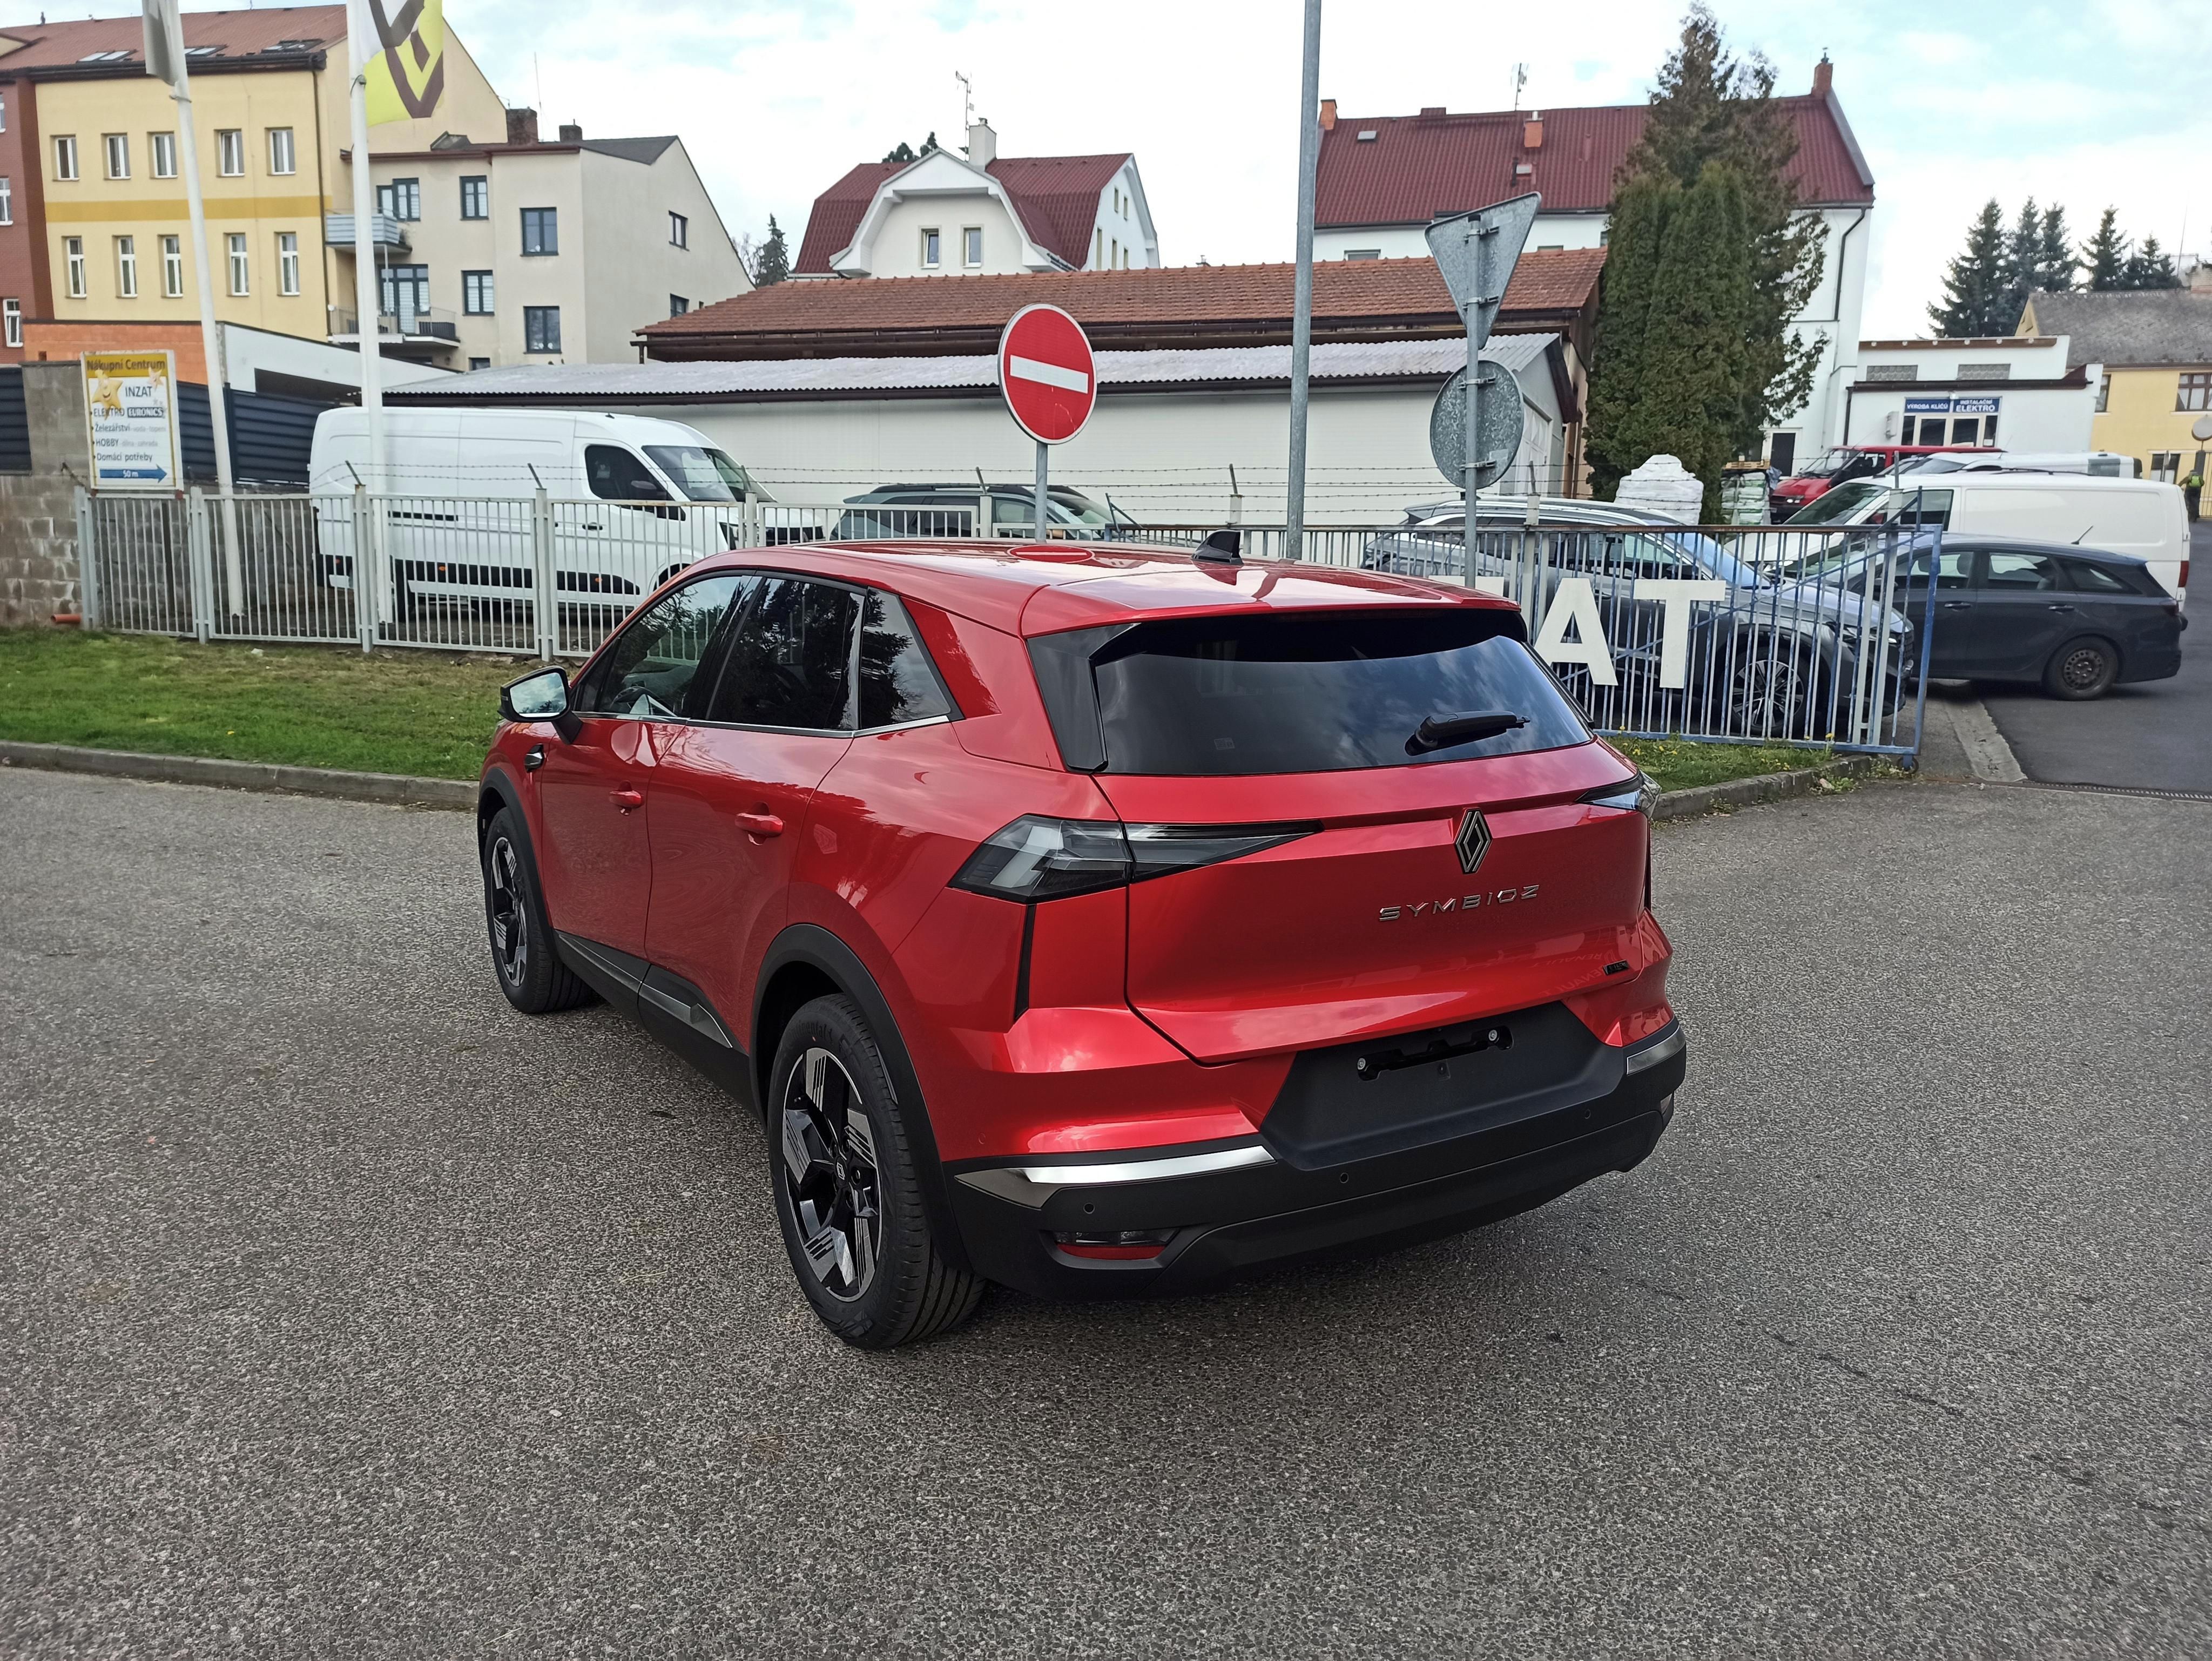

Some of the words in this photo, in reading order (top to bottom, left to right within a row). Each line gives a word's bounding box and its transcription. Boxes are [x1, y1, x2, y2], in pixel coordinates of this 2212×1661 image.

[87, 359, 123, 372] Nákupní
[125, 359, 165, 370] Centrum
[125, 386, 152, 397] INZAT
[128, 407, 164, 417] EURONICS
[1955, 404, 1995, 413] ELEKTRO
[95, 423, 130, 432] Železářství
[96, 438, 119, 447] HOBBY
[97, 451, 122, 461] Domácí
[125, 452, 152, 463] potřeby
[1428, 576, 1726, 689] AT
[1378, 884, 1540, 922] SYMBIOZ
